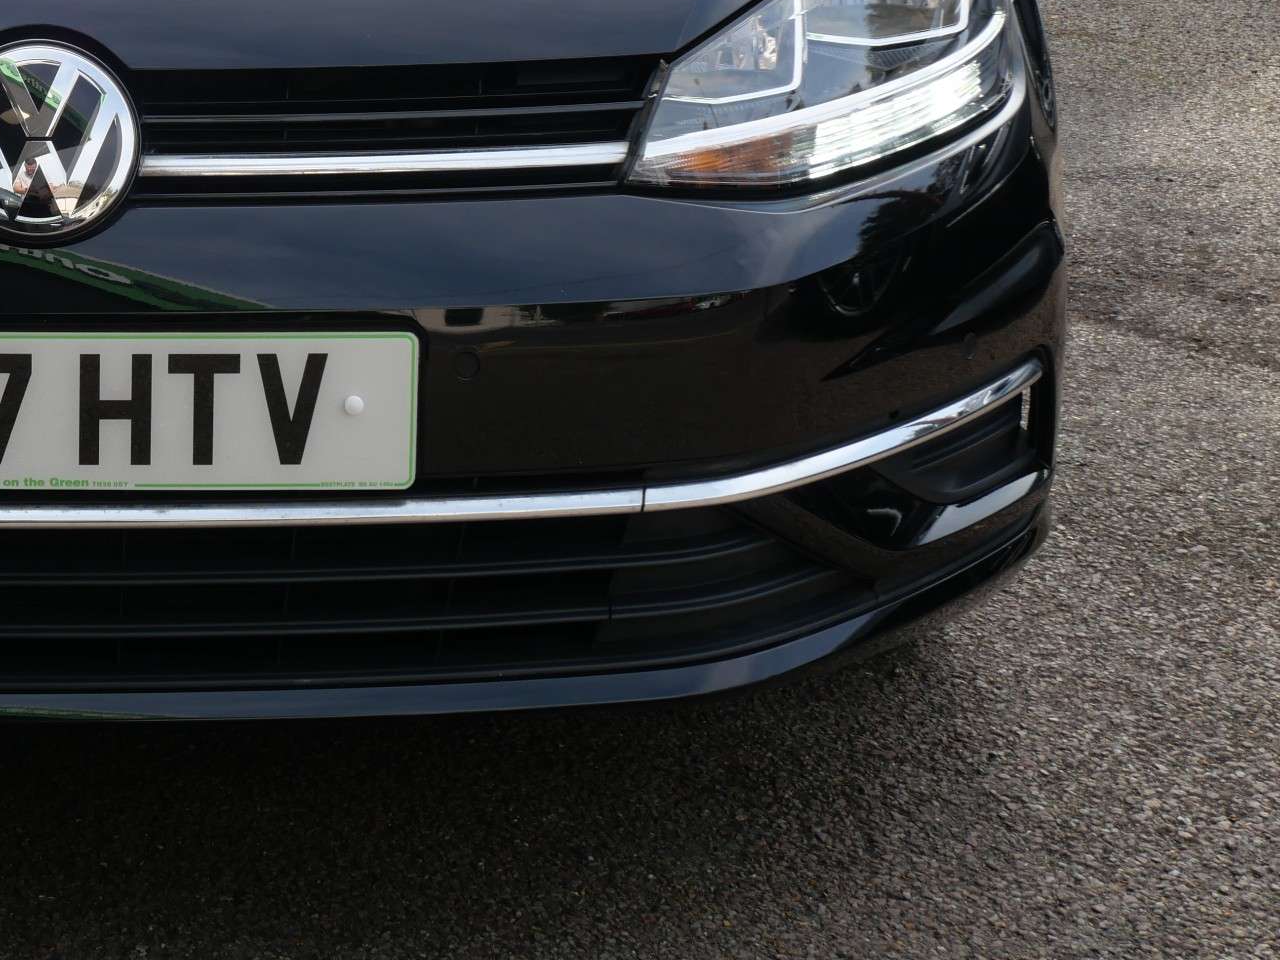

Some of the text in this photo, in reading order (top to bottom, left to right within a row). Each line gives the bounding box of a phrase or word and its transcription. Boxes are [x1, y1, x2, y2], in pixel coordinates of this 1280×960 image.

[78, 353, 329, 465] HTV
[3, 479, 20, 487] on
[23, 477, 45, 487] the
[49, 477, 90, 488] Green
